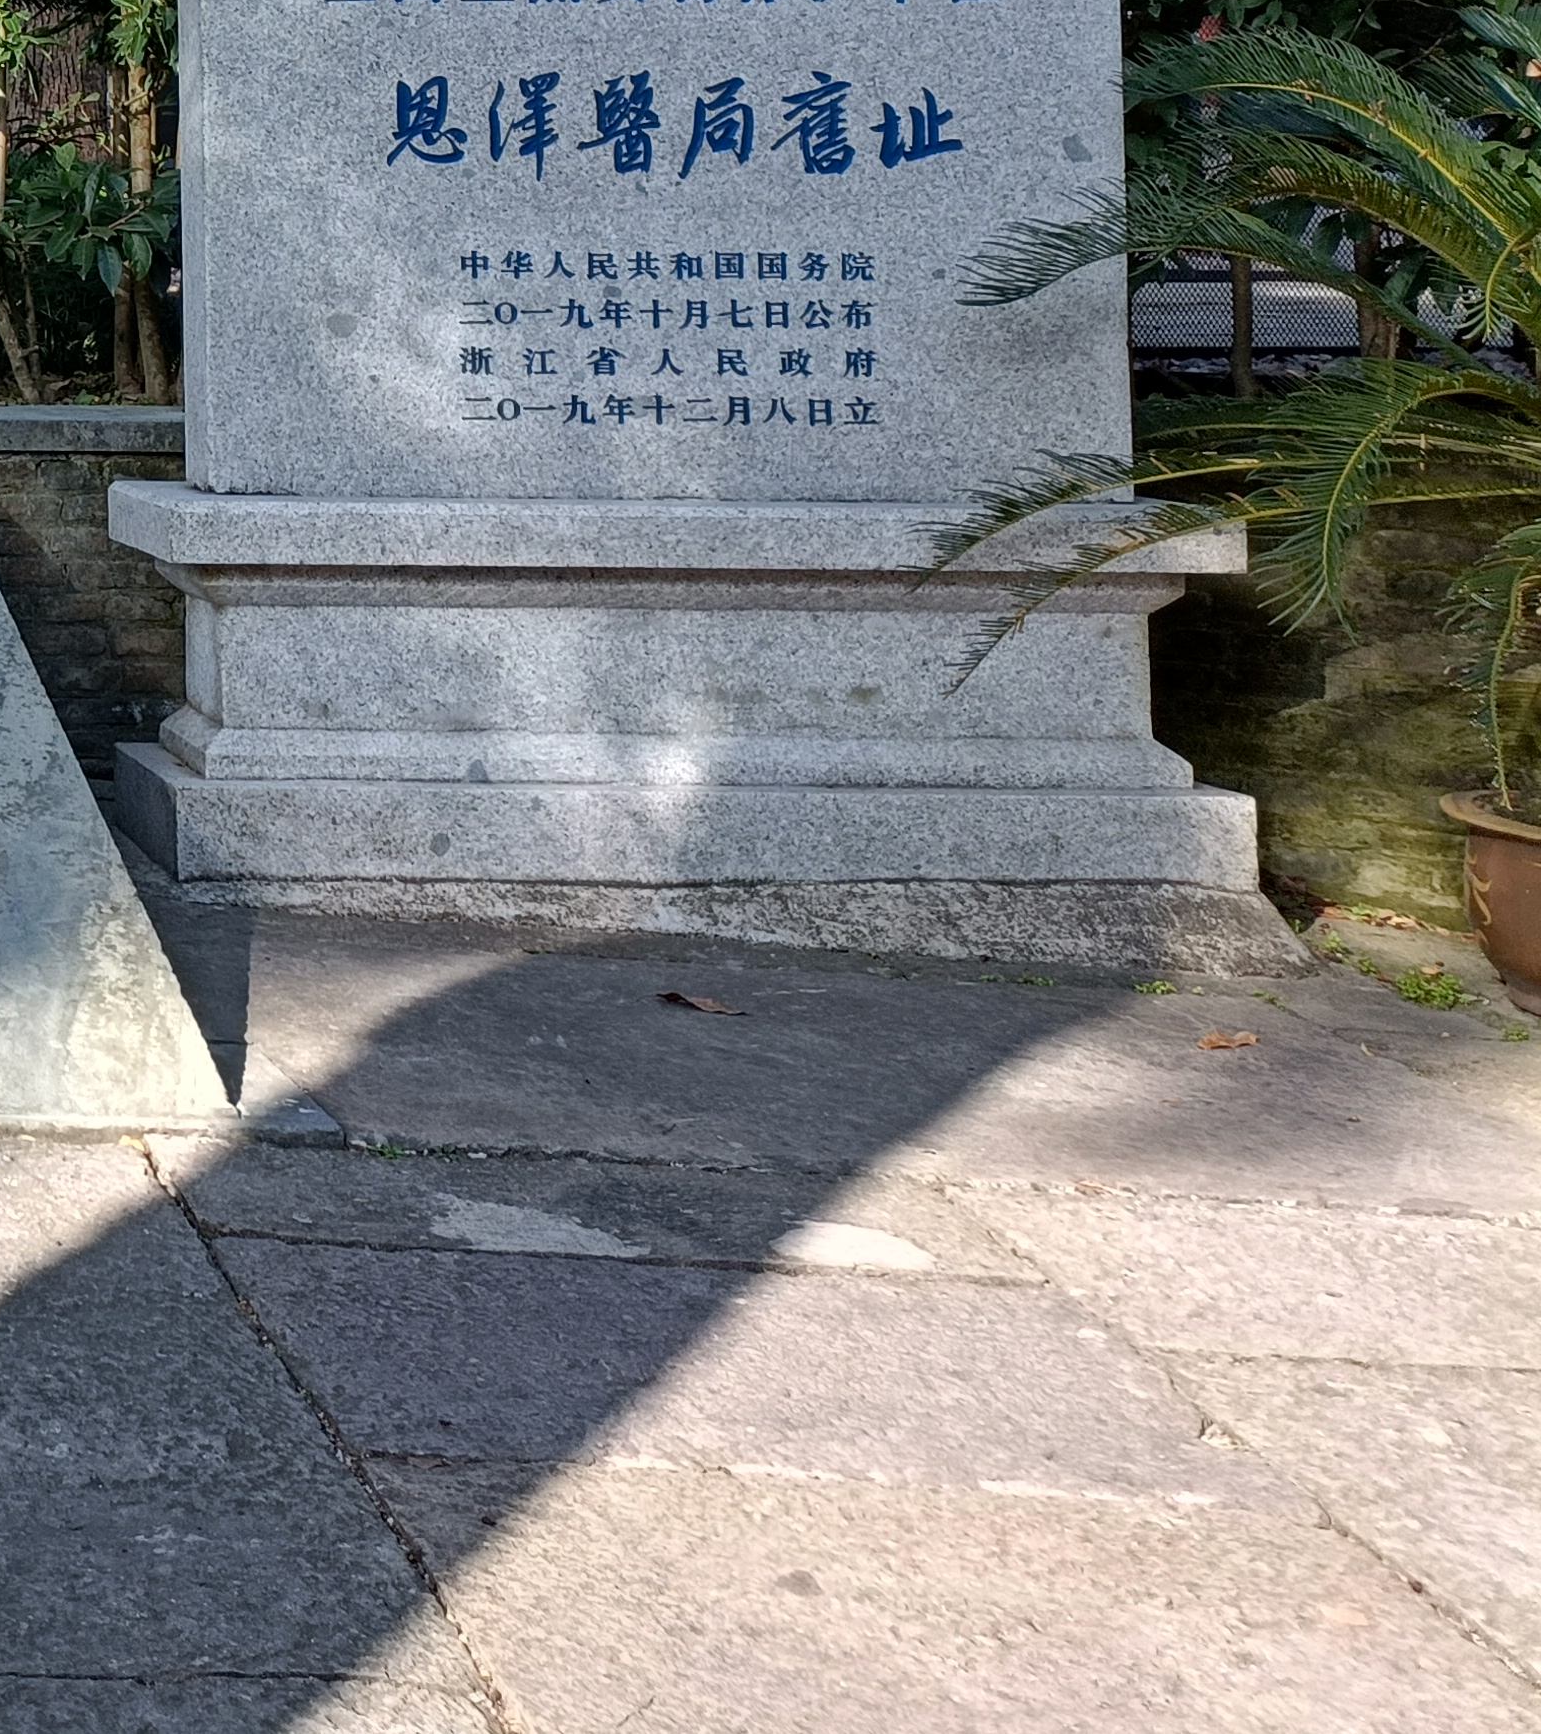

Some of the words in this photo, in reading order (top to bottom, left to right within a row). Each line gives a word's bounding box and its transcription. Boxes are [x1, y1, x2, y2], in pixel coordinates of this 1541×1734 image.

[460, 250, 875, 282] 中华人民共和国国务院
[459, 347, 878, 378] 浙江省人民政府
